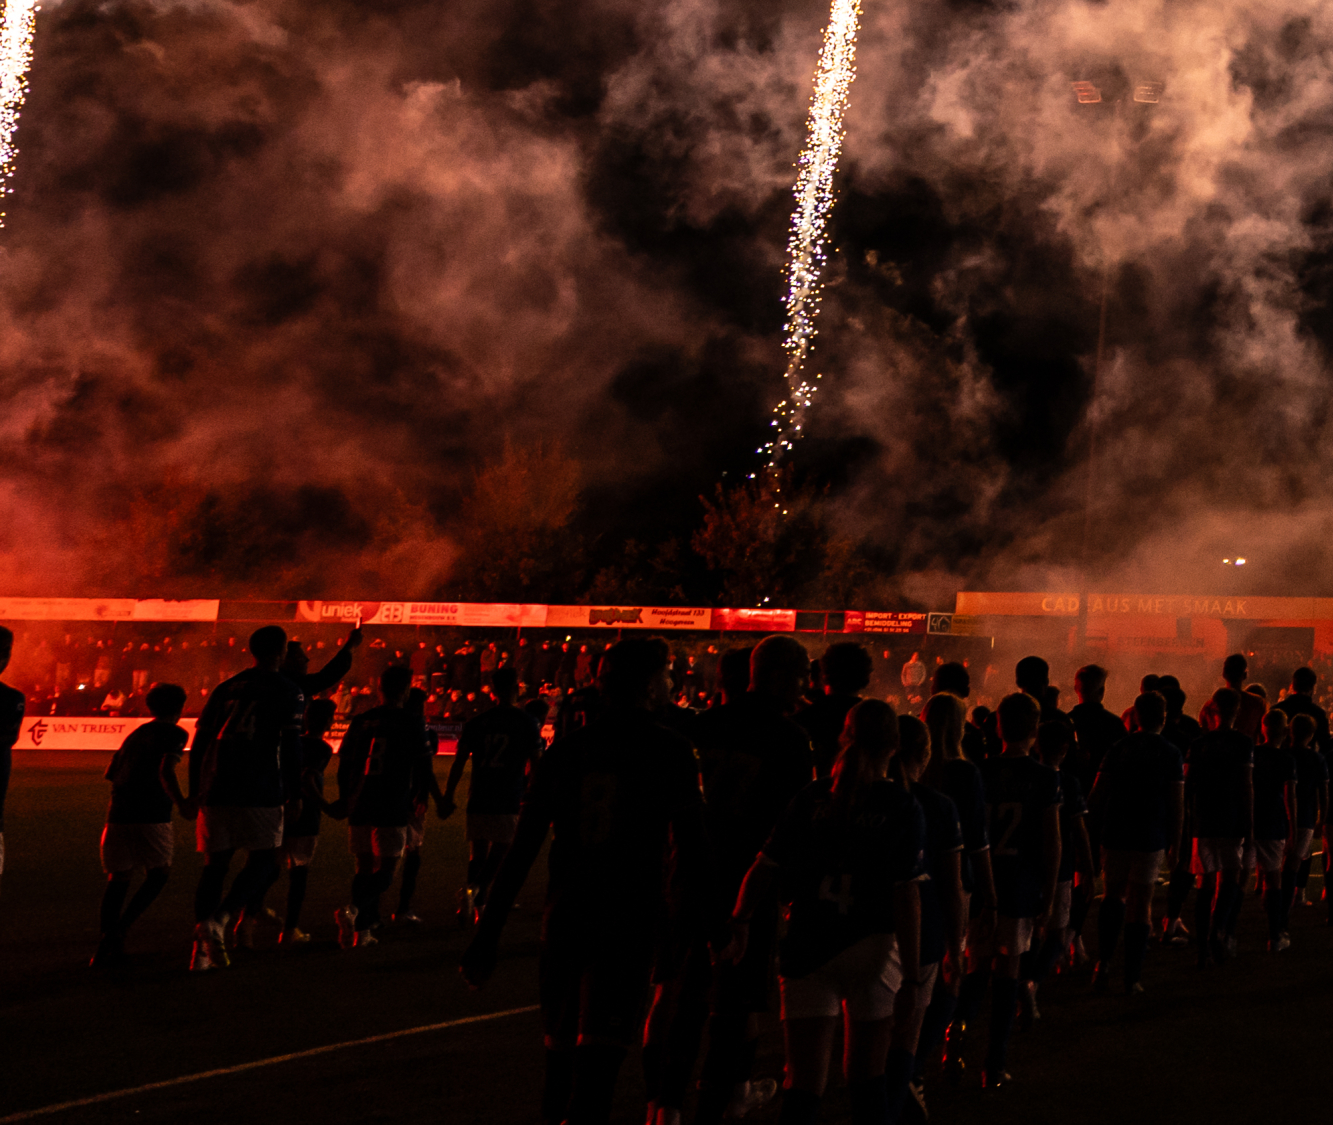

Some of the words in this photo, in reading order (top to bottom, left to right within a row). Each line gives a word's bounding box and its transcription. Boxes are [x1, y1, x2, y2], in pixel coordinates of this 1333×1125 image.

[321, 603, 363, 618] uniek
[410, 604, 459, 614] BUNING
[1041, 597, 1130, 614] CADAUS
[1137, 598, 1173, 614] MET
[1184, 599, 1247, 616] SMAAK
[52, 723, 79, 734] VAN
[81, 724, 126, 734] TRIEST
